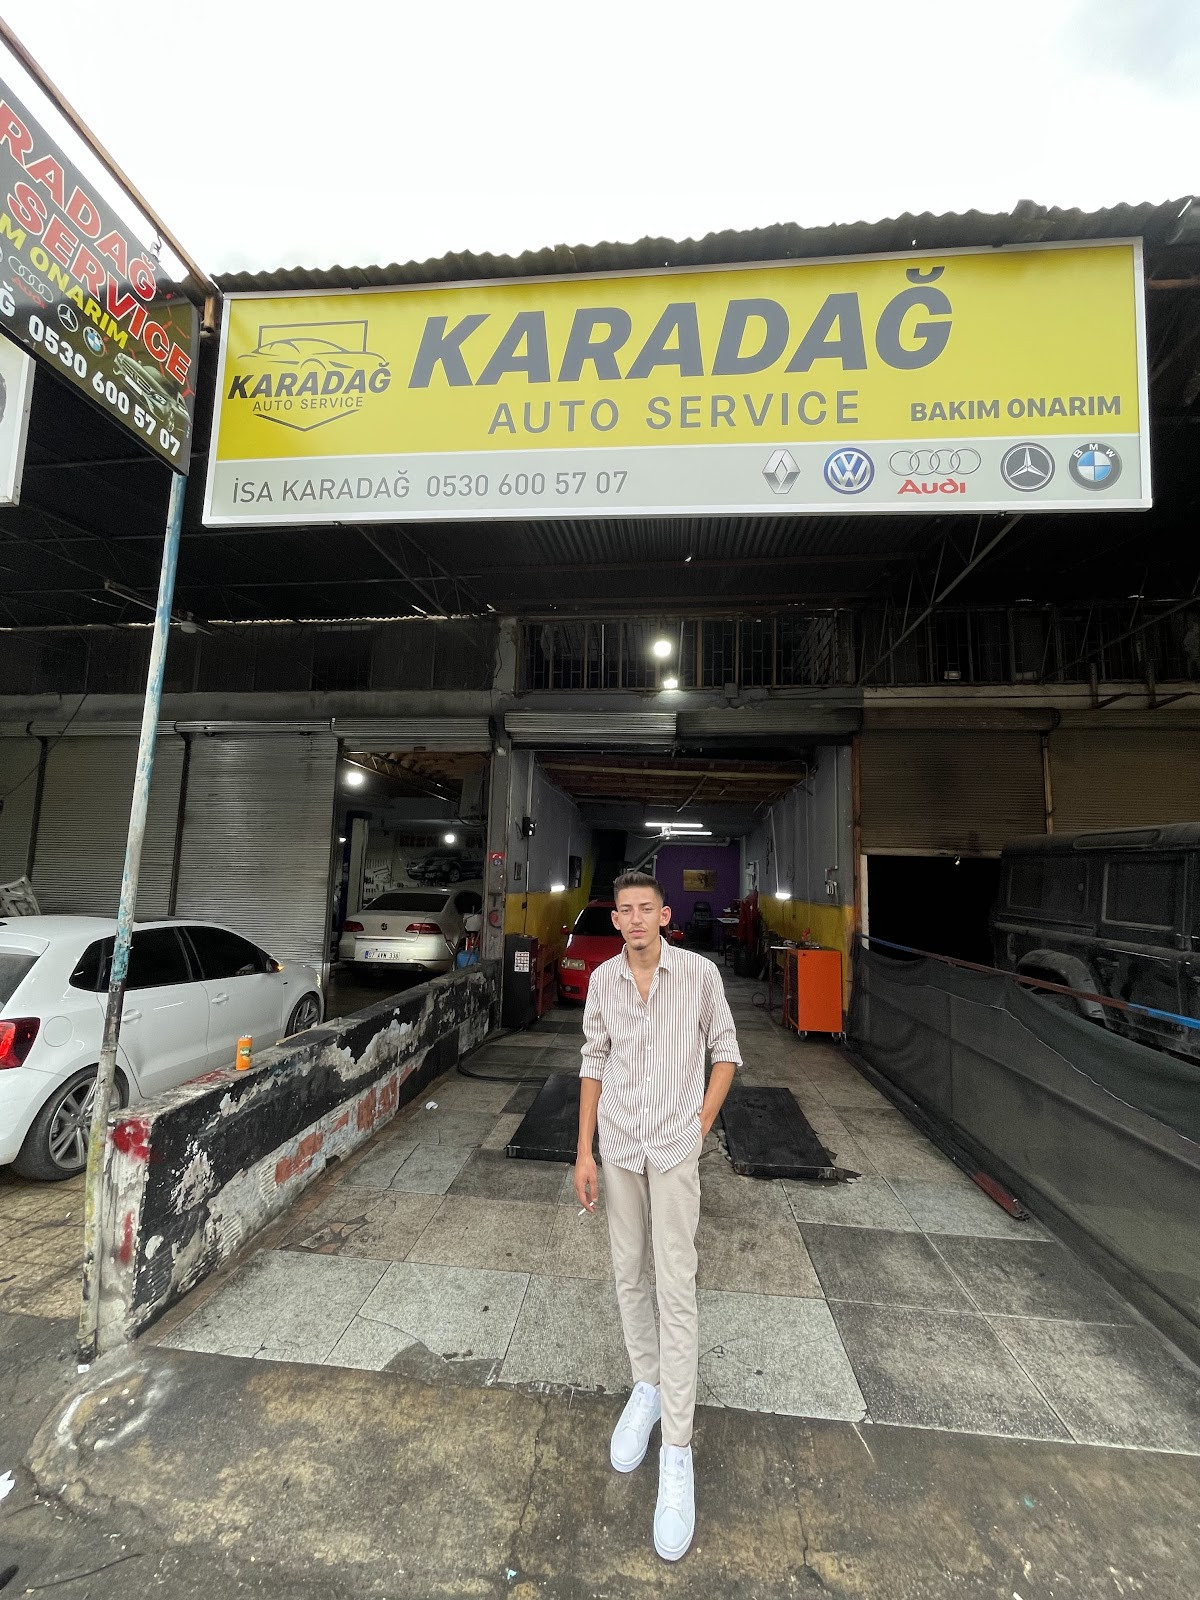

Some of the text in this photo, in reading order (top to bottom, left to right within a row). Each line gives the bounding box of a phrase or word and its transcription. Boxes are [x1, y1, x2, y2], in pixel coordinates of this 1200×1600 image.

[7, 181, 192, 386] SERVICE
[30, 246, 129, 350] ONARIM
[408, 266, 953, 388] KARADAĞ
[29, 315, 87, 378] 0530
[92, 371, 130, 415] 600
[133, 403, 157, 436] 57
[160, 428, 181, 456] 07
[227, 362, 391, 399] KARADAĞ
[253, 397, 363, 412] AUTO SERVICE
[488, 390, 859, 435] AUTO SERVICE
[910, 395, 1121, 422] BAKIM ONARIM
[1073, 443, 1116, 459] BMW
[233, 470, 628, 504] İSA KARADAĞ 0530 600 57 07
